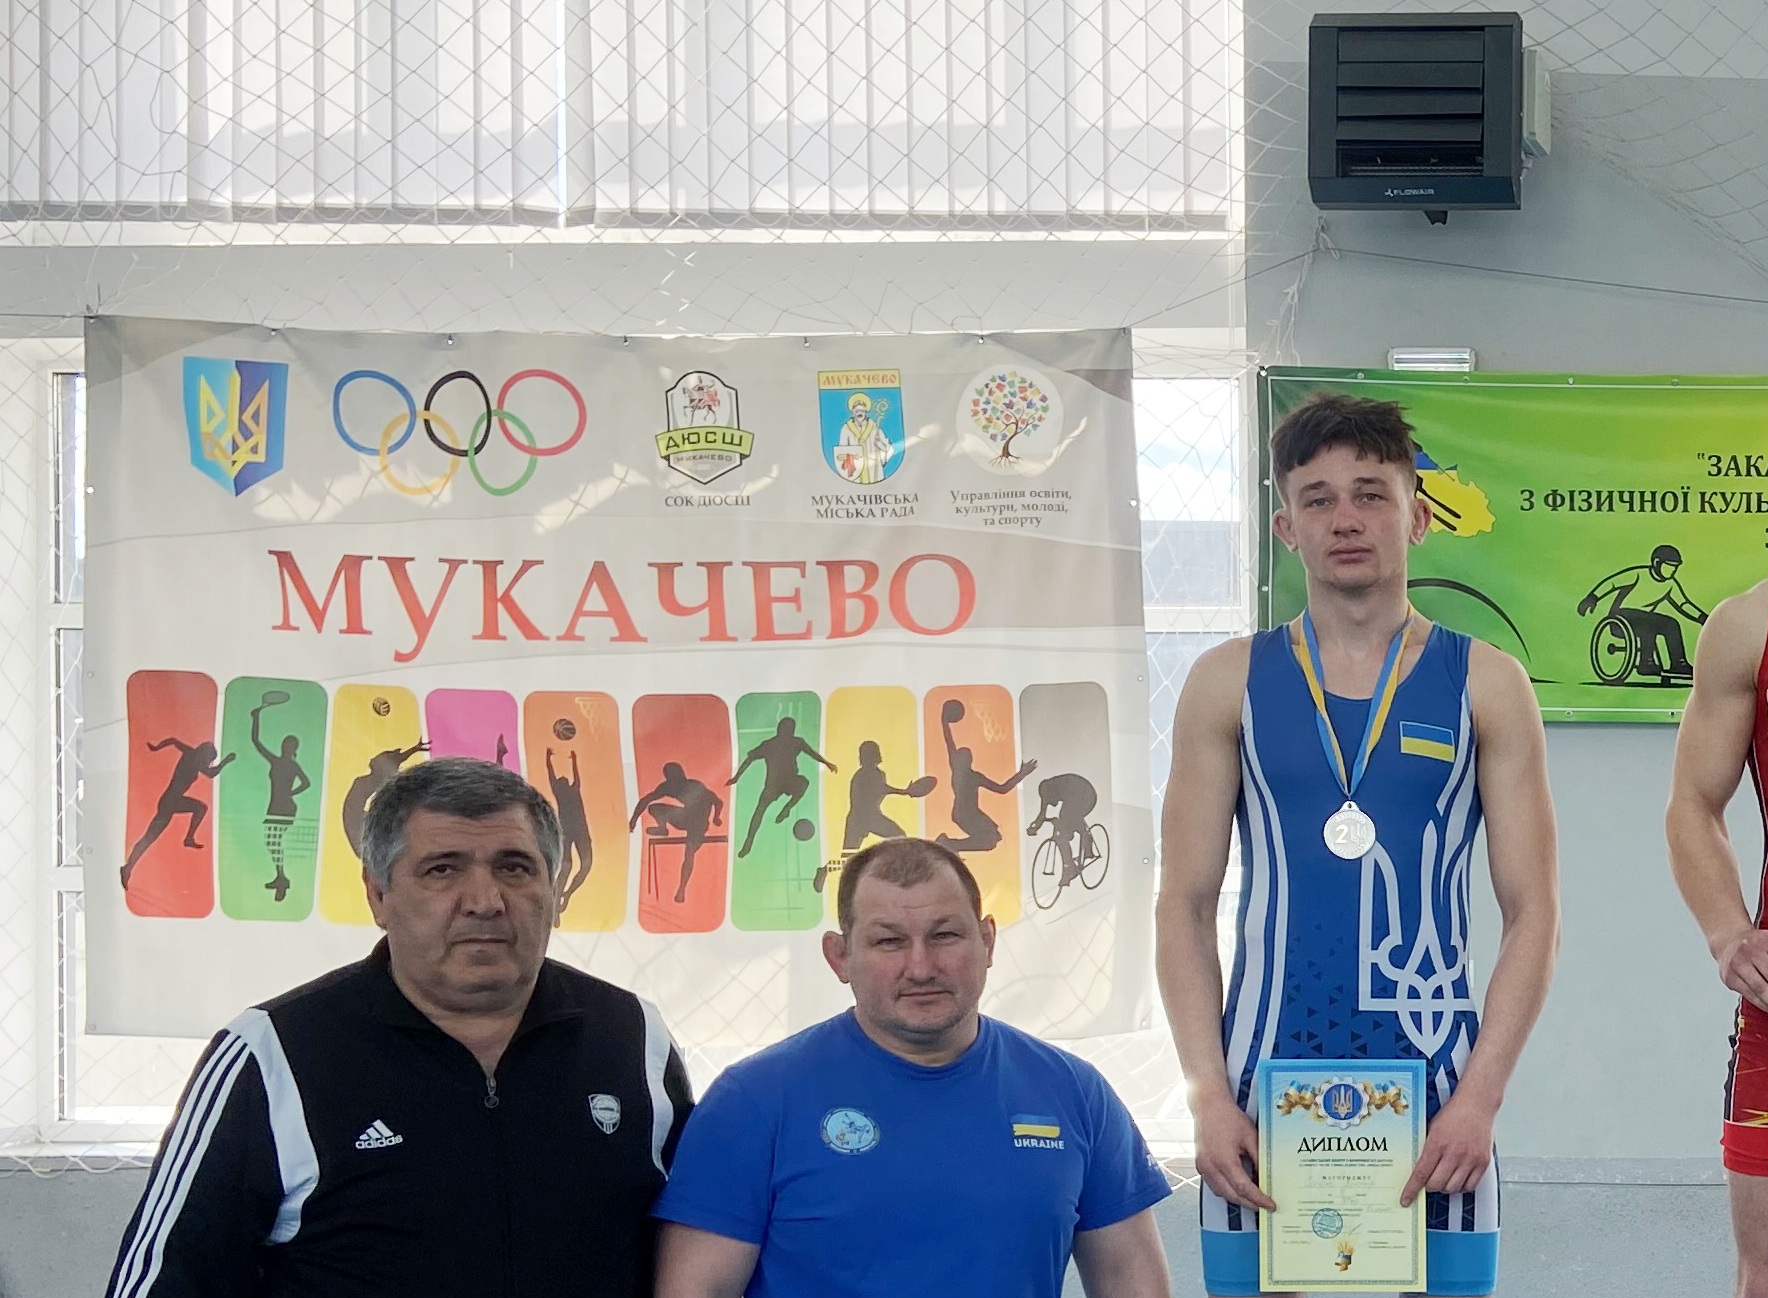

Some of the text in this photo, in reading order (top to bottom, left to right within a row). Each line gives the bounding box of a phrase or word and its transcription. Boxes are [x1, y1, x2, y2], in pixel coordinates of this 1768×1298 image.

[822, 373, 897, 387] МУКАЧЕВО
[665, 431, 743, 451] ДЮСШ
[664, 495, 751, 508] СОК ДЮСШ
[811, 493, 919, 509] МУКАЧІВСЬКА
[950, 487, 1072, 504] Управління освіти,
[1520, 489, 1535, 512] З
[1543, 486, 1690, 513] ФІЗИЧНОЇ
[816, 506, 915, 519] МІСЬКА РАДА
[955, 500, 1068, 517] культури, молоді,
[983, 516, 1043, 528] та спорту
[268, 549, 977, 663] МУКАЧЕВО
[1335, 824, 1348, 844] 2
[355, 1134, 403, 1149] adidas
[1013, 1138, 1065, 1150] UKRAINE
[1297, 1137, 1389, 1153] ДИПЛОМ
